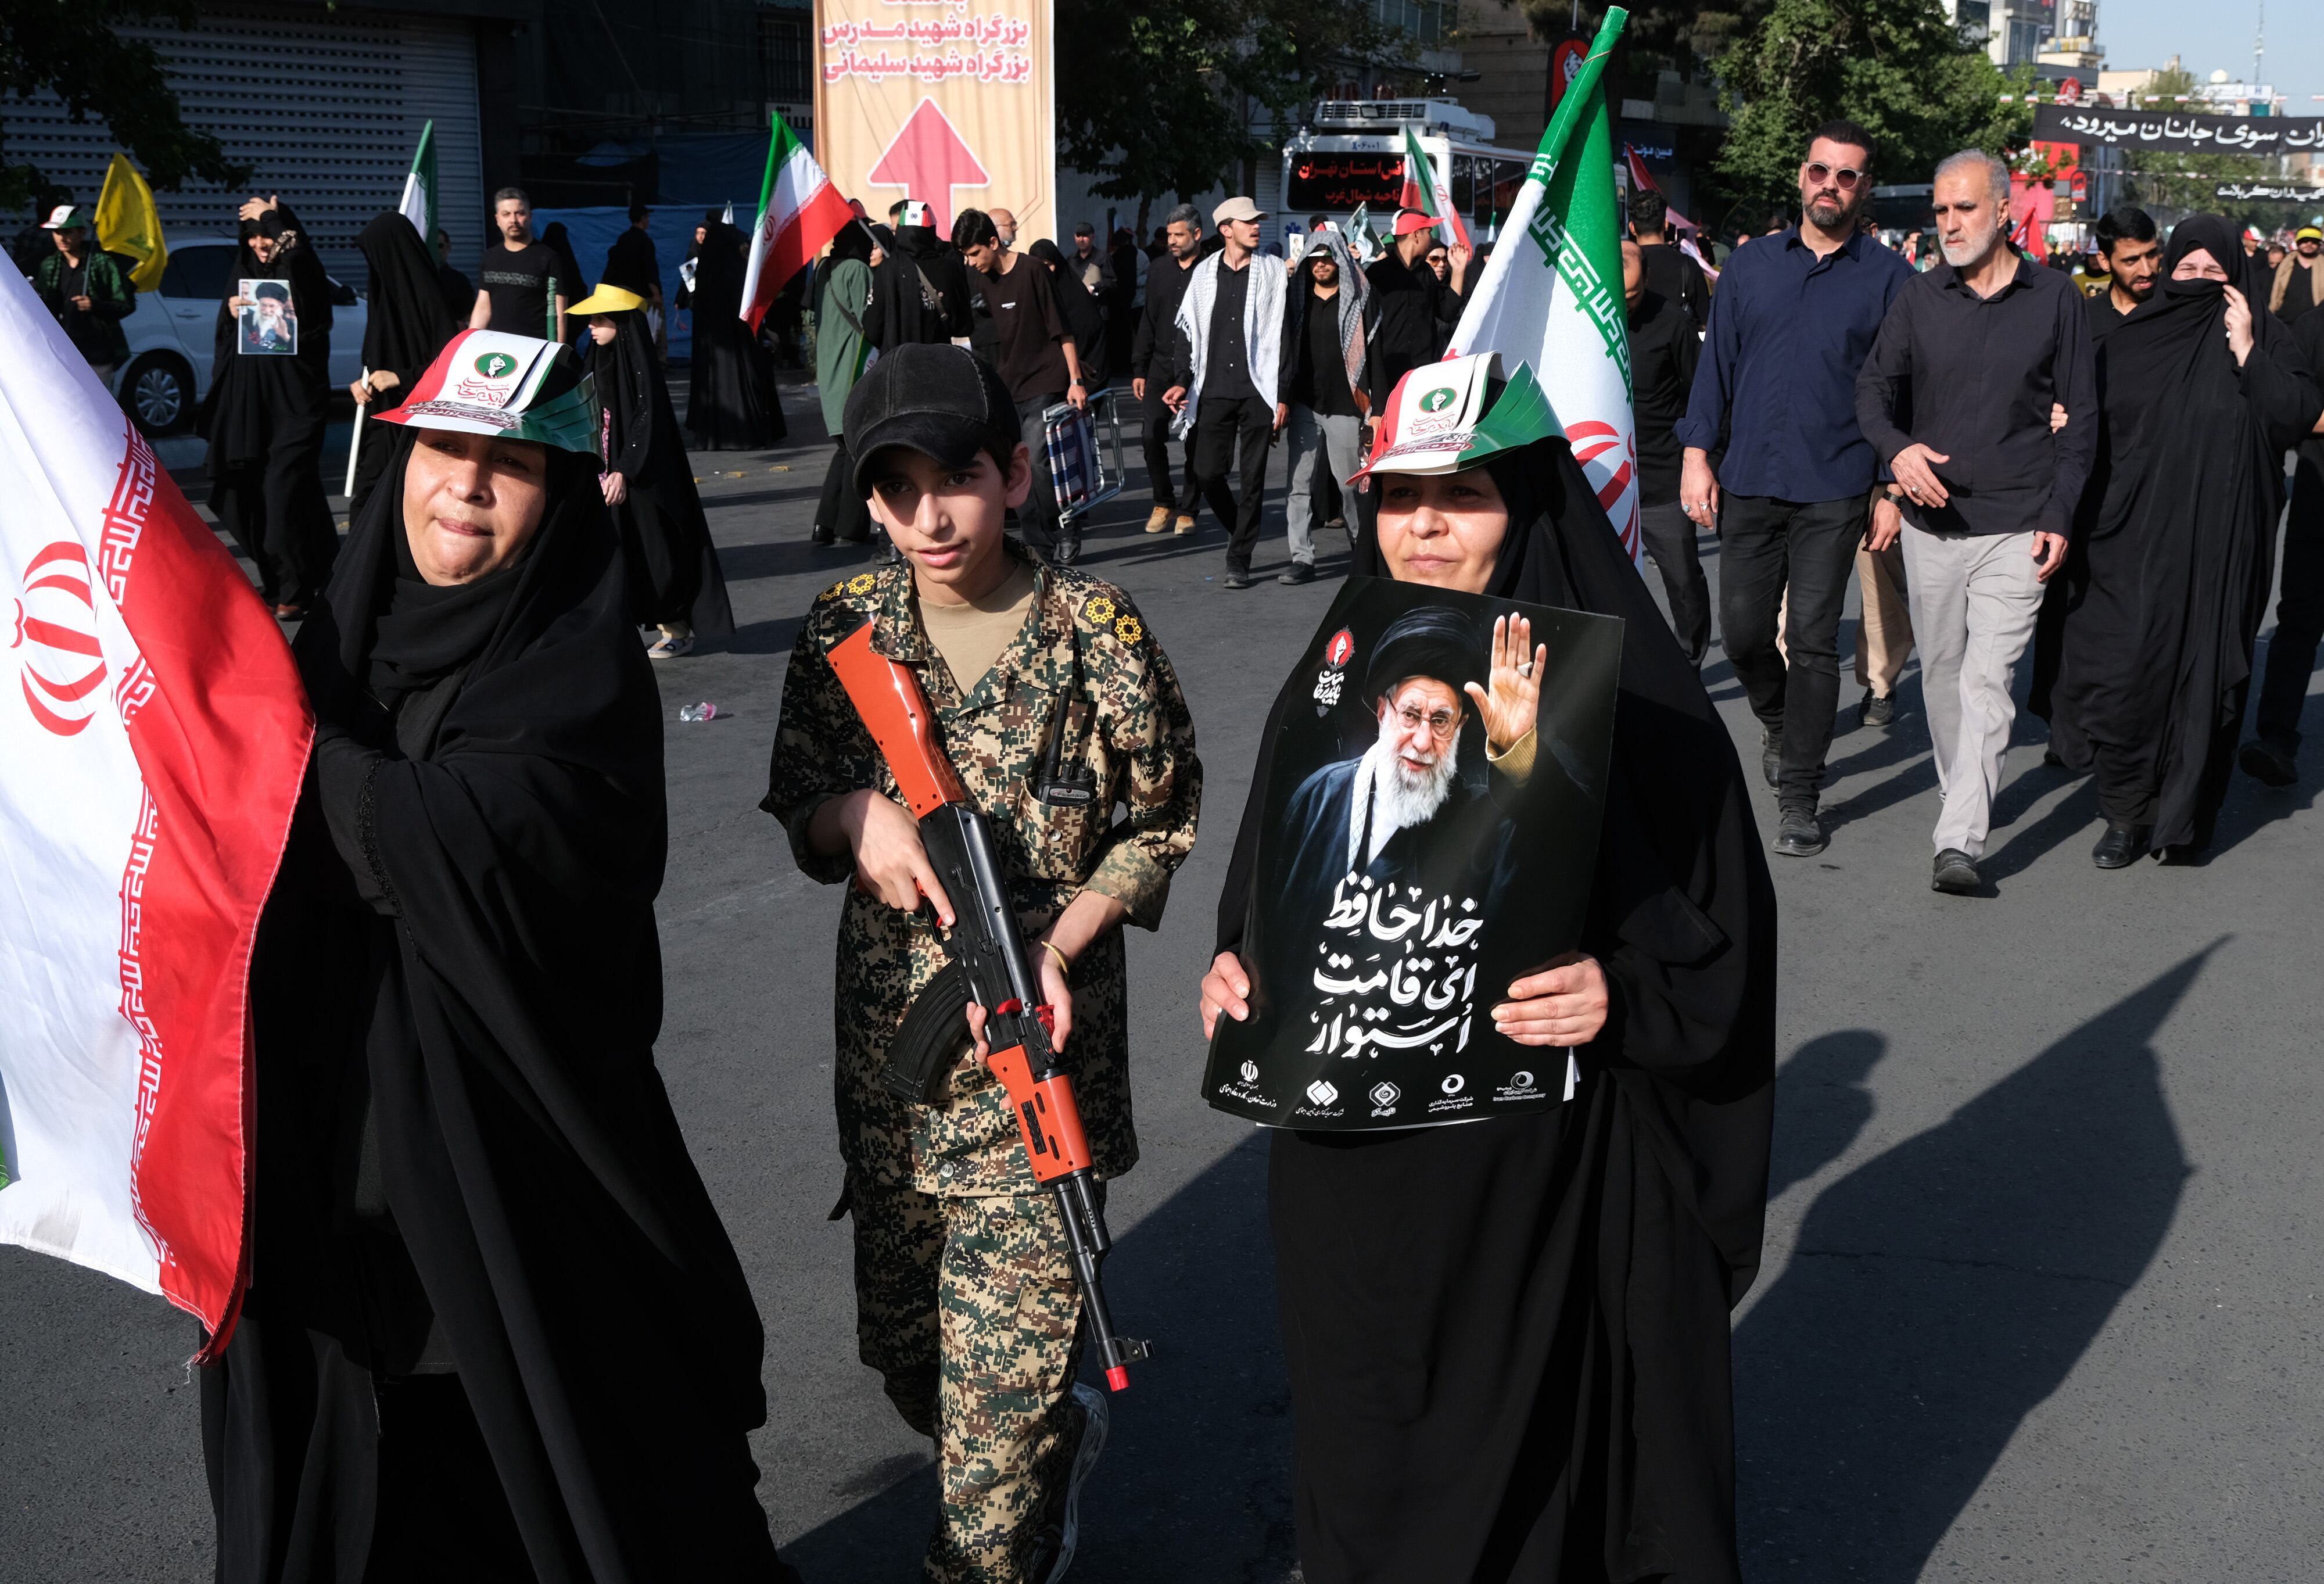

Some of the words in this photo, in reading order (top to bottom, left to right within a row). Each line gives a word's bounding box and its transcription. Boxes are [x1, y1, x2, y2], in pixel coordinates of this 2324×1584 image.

[823, 19, 905, 44] مدرس
[908, 15, 961, 44] شهید
[965, 15, 1028, 45] بزرگراه
[824, 51, 908, 81] سلیمانی
[910, 50, 963, 80] شهید
[966, 50, 1030, 81] بزرگراه
[2140, 117, 2213, 146] جانان
[2215, 124, 2279, 149] سوی
[1299, 160, 1338, 180] تهران
[1339, 160, 1381, 178] استان
[1325, 189, 1346, 204] غرب
[1346, 189, 1372, 205] شمال
[1374, 189, 1400, 202] ناحیه
[1260, 1098, 1277, 1108] وزارت
[1371, 1107, 1396, 1117] تاپیکو
[1428, 1104, 1457, 1113] پتروشیمی
